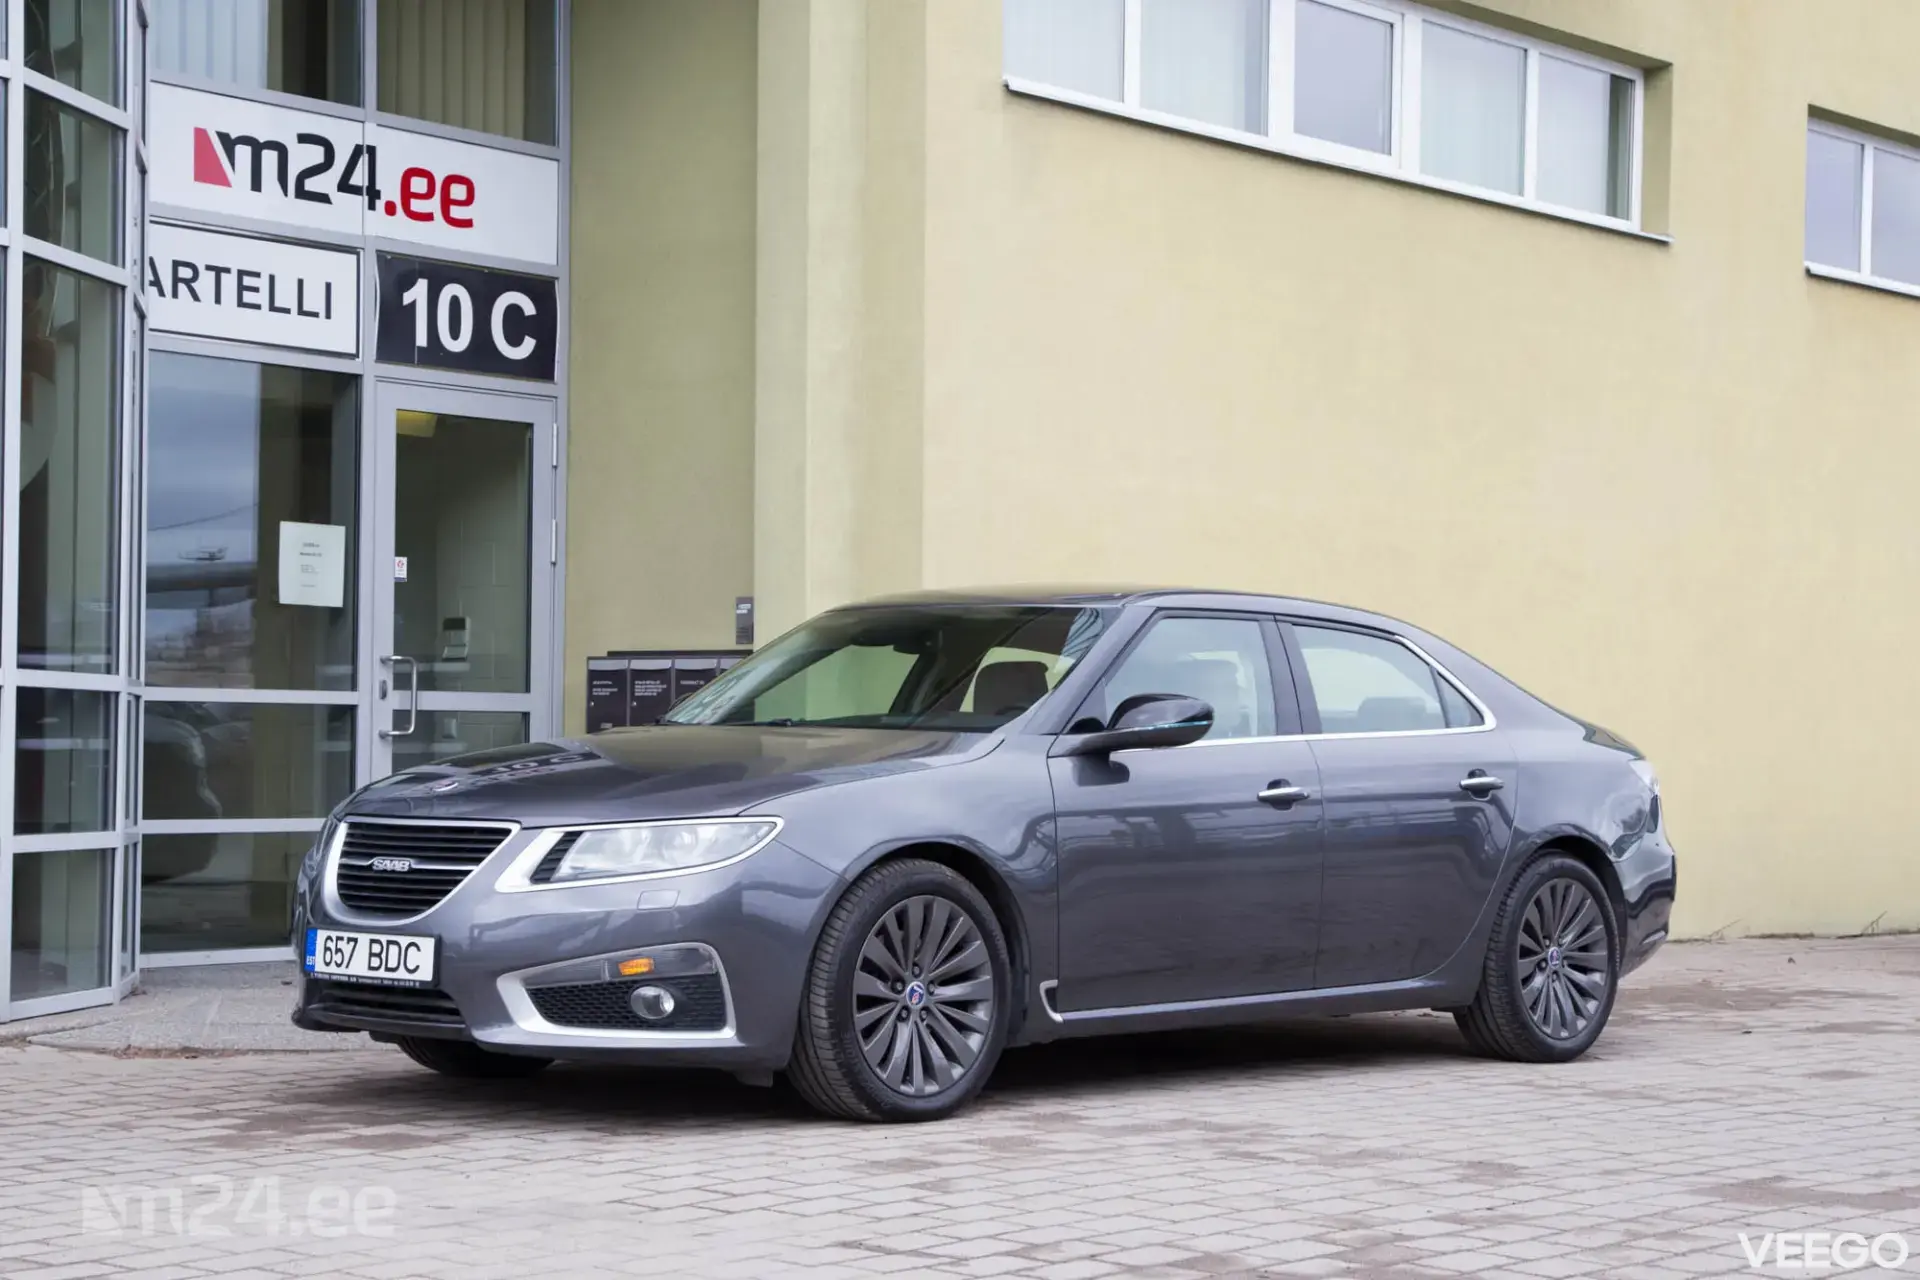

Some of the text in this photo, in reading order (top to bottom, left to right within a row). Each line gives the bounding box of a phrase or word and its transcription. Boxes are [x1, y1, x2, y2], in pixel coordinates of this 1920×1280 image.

[214, 130, 476, 228] m24.ee
[402, 278, 537, 360] 10 C
[372, 859, 410, 872] SAAB
[306, 955, 316, 966] EST
[323, 935, 421, 974] 657 BDC
